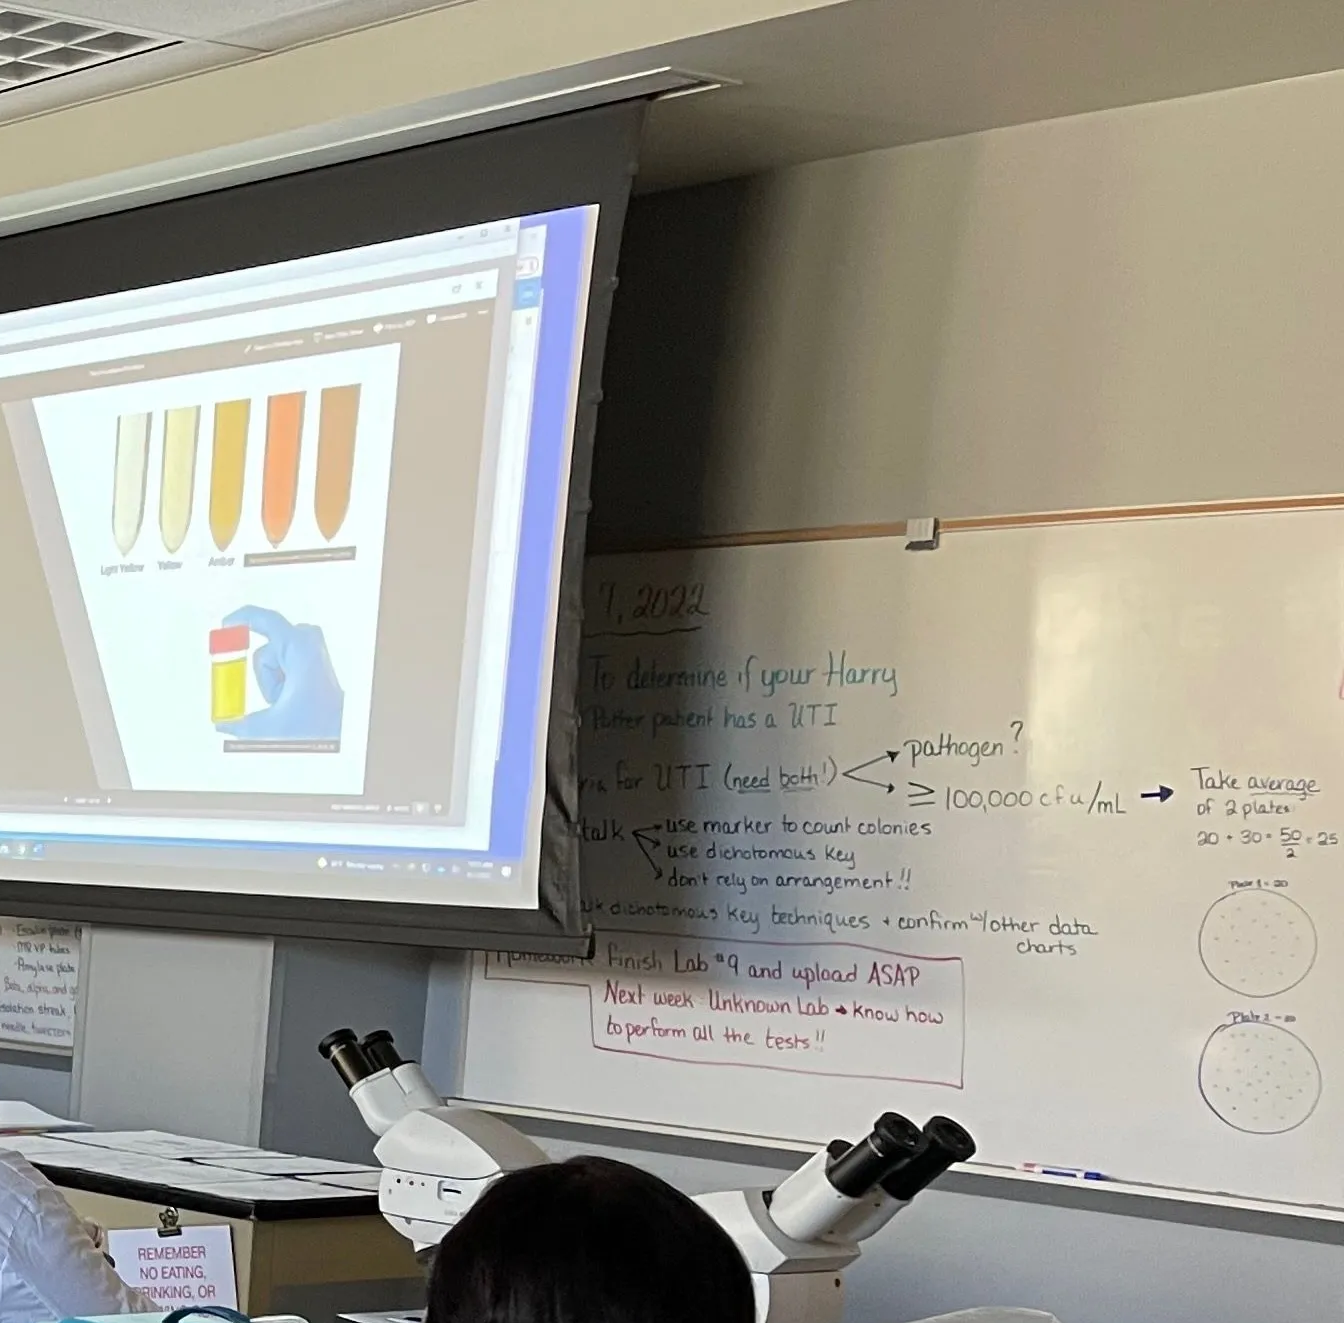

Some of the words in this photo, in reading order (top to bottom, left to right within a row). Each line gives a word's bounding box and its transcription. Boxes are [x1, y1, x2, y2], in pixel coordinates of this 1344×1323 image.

[631, 582, 710, 619] 2022
[587, 654, 616, 691] To
[626, 654, 729, 691] determine
[738, 654, 760, 693] if
[760, 666, 817, 698] your
[825, 650, 898, 698] Harry
[586, 704, 645, 731] Potter
[652, 706, 713, 740] patient
[723, 706, 758, 730] has
[764, 714, 778, 729] a
[788, 702, 839, 729] UTI
[616, 758, 645, 790] for
[654, 762, 712, 793] UTI
[724, 762, 771, 794] (need
[1189, 766, 1242, 791] Take
[1247, 775, 1321, 801] average
[945, 785, 1034, 813] 100,000
[1196, 798, 1216, 817] of
[1225, 799, 1238, 816] 2
[1242, 800, 1291, 820] plates
[666, 819, 699, 835] use
[703, 815, 775, 836] marker
[782, 814, 800, 835] to
[801, 817, 853, 836] count
[857, 816, 933, 837] colonies
[1197, 830, 1220, 847] 20
[1239, 829, 1263, 845] 30
[1317, 831, 1339, 847] 25
[667, 845, 699, 860] use
[705, 836, 817, 861] dichotomous
[824, 846, 857, 870] key
[667, 865, 710, 888] don't
[716, 872, 748, 894] rely
[750, 876, 769, 888] on
[608, 901, 719, 921] dichotomous
[727, 905, 761, 934] key
[771, 904, 871, 934] techniques
[897, 909, 969, 931] confirm
[1048, 914, 1099, 937] data
[1016, 939, 1078, 956] charts
[607, 942, 663, 974] Finish
[673, 948, 710, 974] Lab
[748, 960, 784, 982] and
[791, 956, 859, 993] upload
[867, 961, 921, 987] ASAP
[603, 979, 646, 1007] Next
[652, 988, 696, 1009] week
[708, 987, 793, 1015] Unknown
[796, 991, 830, 1016] Lab
[852, 999, 904, 1022] know
[905, 1003, 945, 1025] how
[606, 1014, 624, 1038] to
[624, 1018, 688, 1045] perform
[692, 1019, 715, 1041] all
[722, 1021, 756, 1047] the
[137, 1245, 207, 1261] REMEMBER
[139, 1266, 158, 1280] NO
[161, 1264, 207, 1281] EATING,
[198, 1285, 216, 1299] OR
